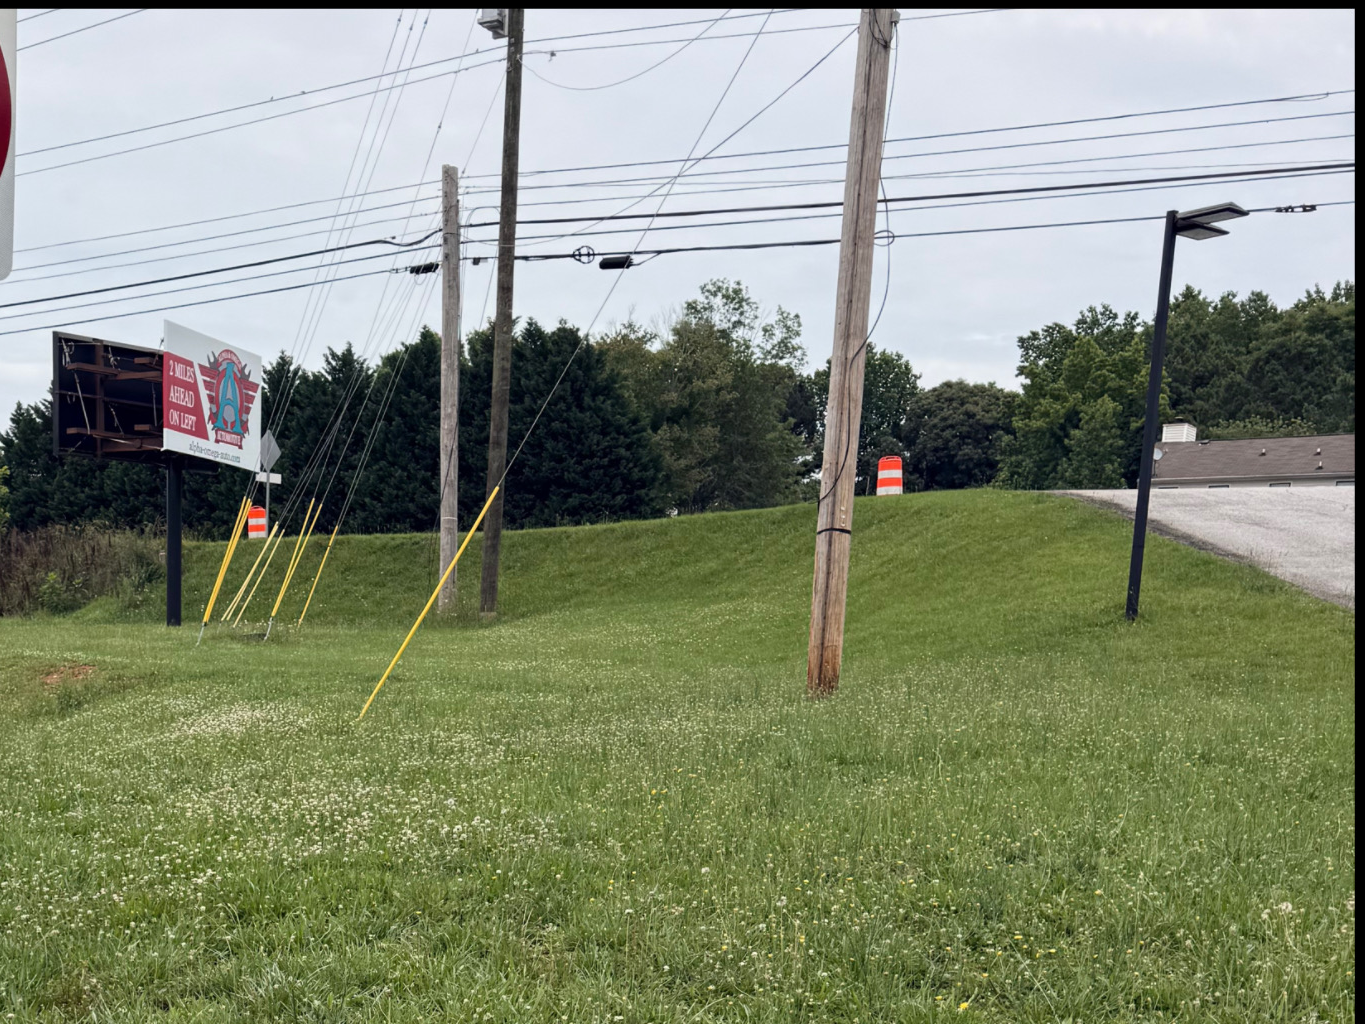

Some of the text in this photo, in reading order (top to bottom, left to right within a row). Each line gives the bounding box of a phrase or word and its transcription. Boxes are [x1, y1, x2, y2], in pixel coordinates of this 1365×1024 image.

[169, 359, 194, 383] 2 MILES
[169, 384, 195, 408] AHEAD
[169, 409, 197, 431] ON LEFT
